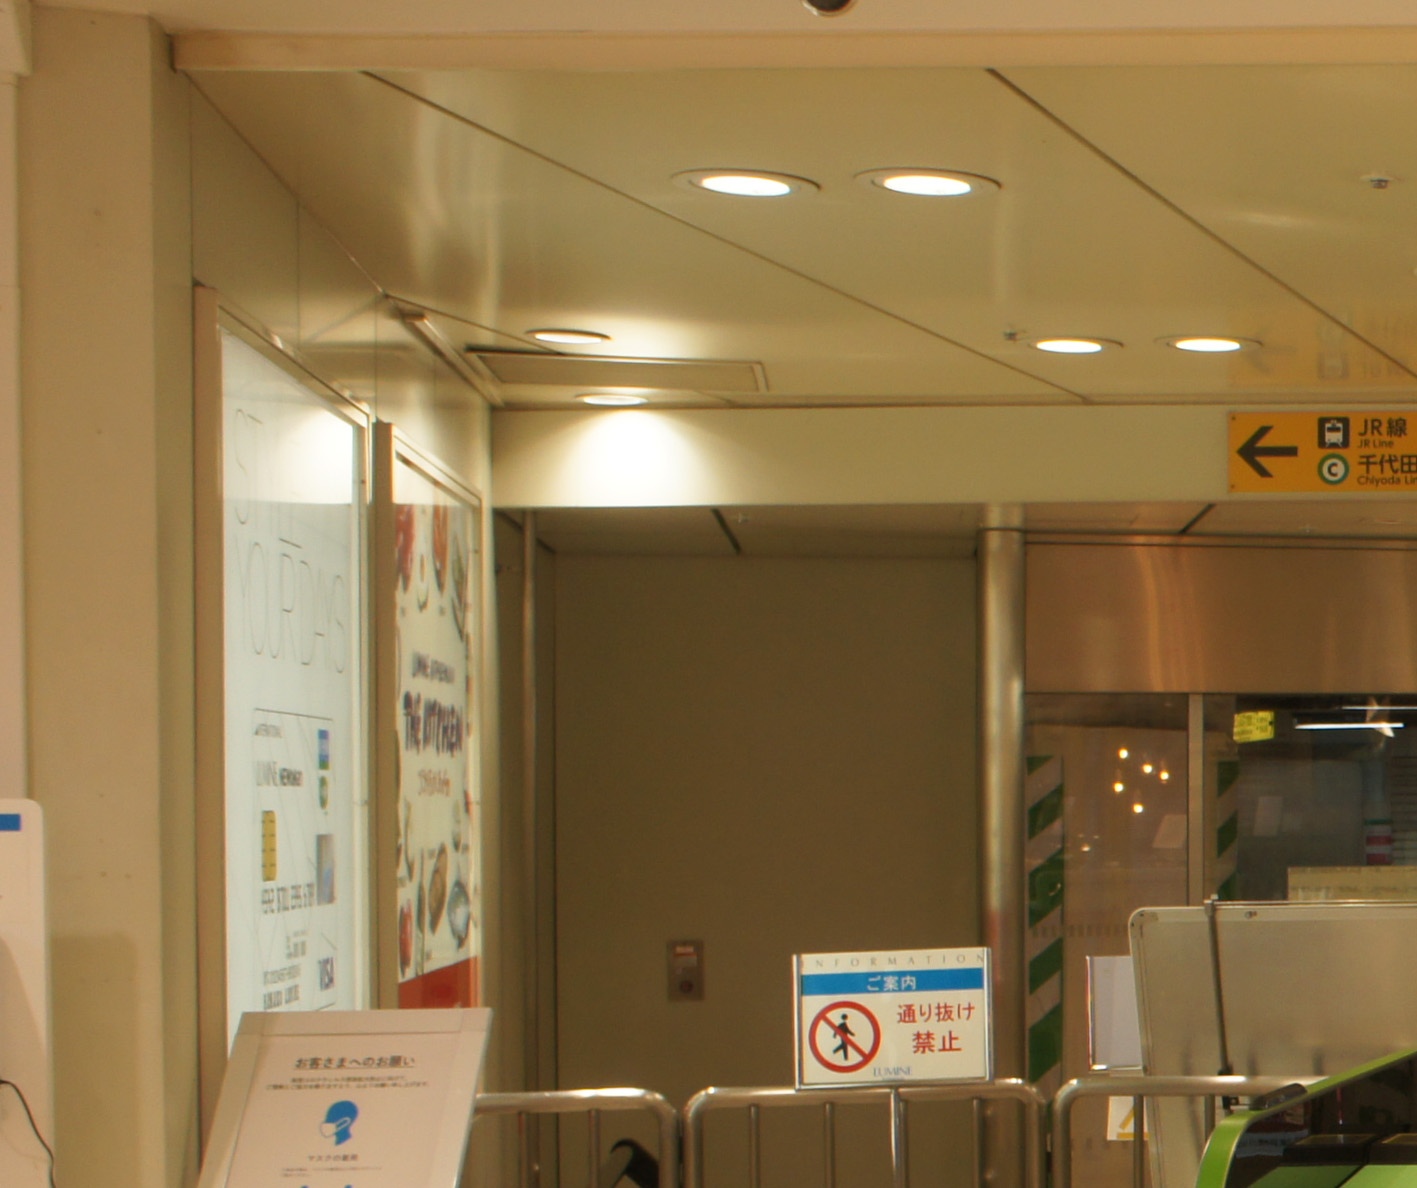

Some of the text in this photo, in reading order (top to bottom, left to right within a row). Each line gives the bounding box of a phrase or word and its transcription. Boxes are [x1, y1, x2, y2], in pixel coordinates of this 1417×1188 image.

[1357, 439, 1394, 448] JR Line
[1327, 462, 1339, 477] C
[1357, 475, 1401, 487] Chiyoda
[867, 975, 916, 991] ご案内
[897, 1002, 975, 1024] 通り抜け
[912, 1030, 962, 1055] 禁止
[294, 1055, 416, 1069] お客さまへのお願い
[873, 1066, 913, 1077] LUMINE
